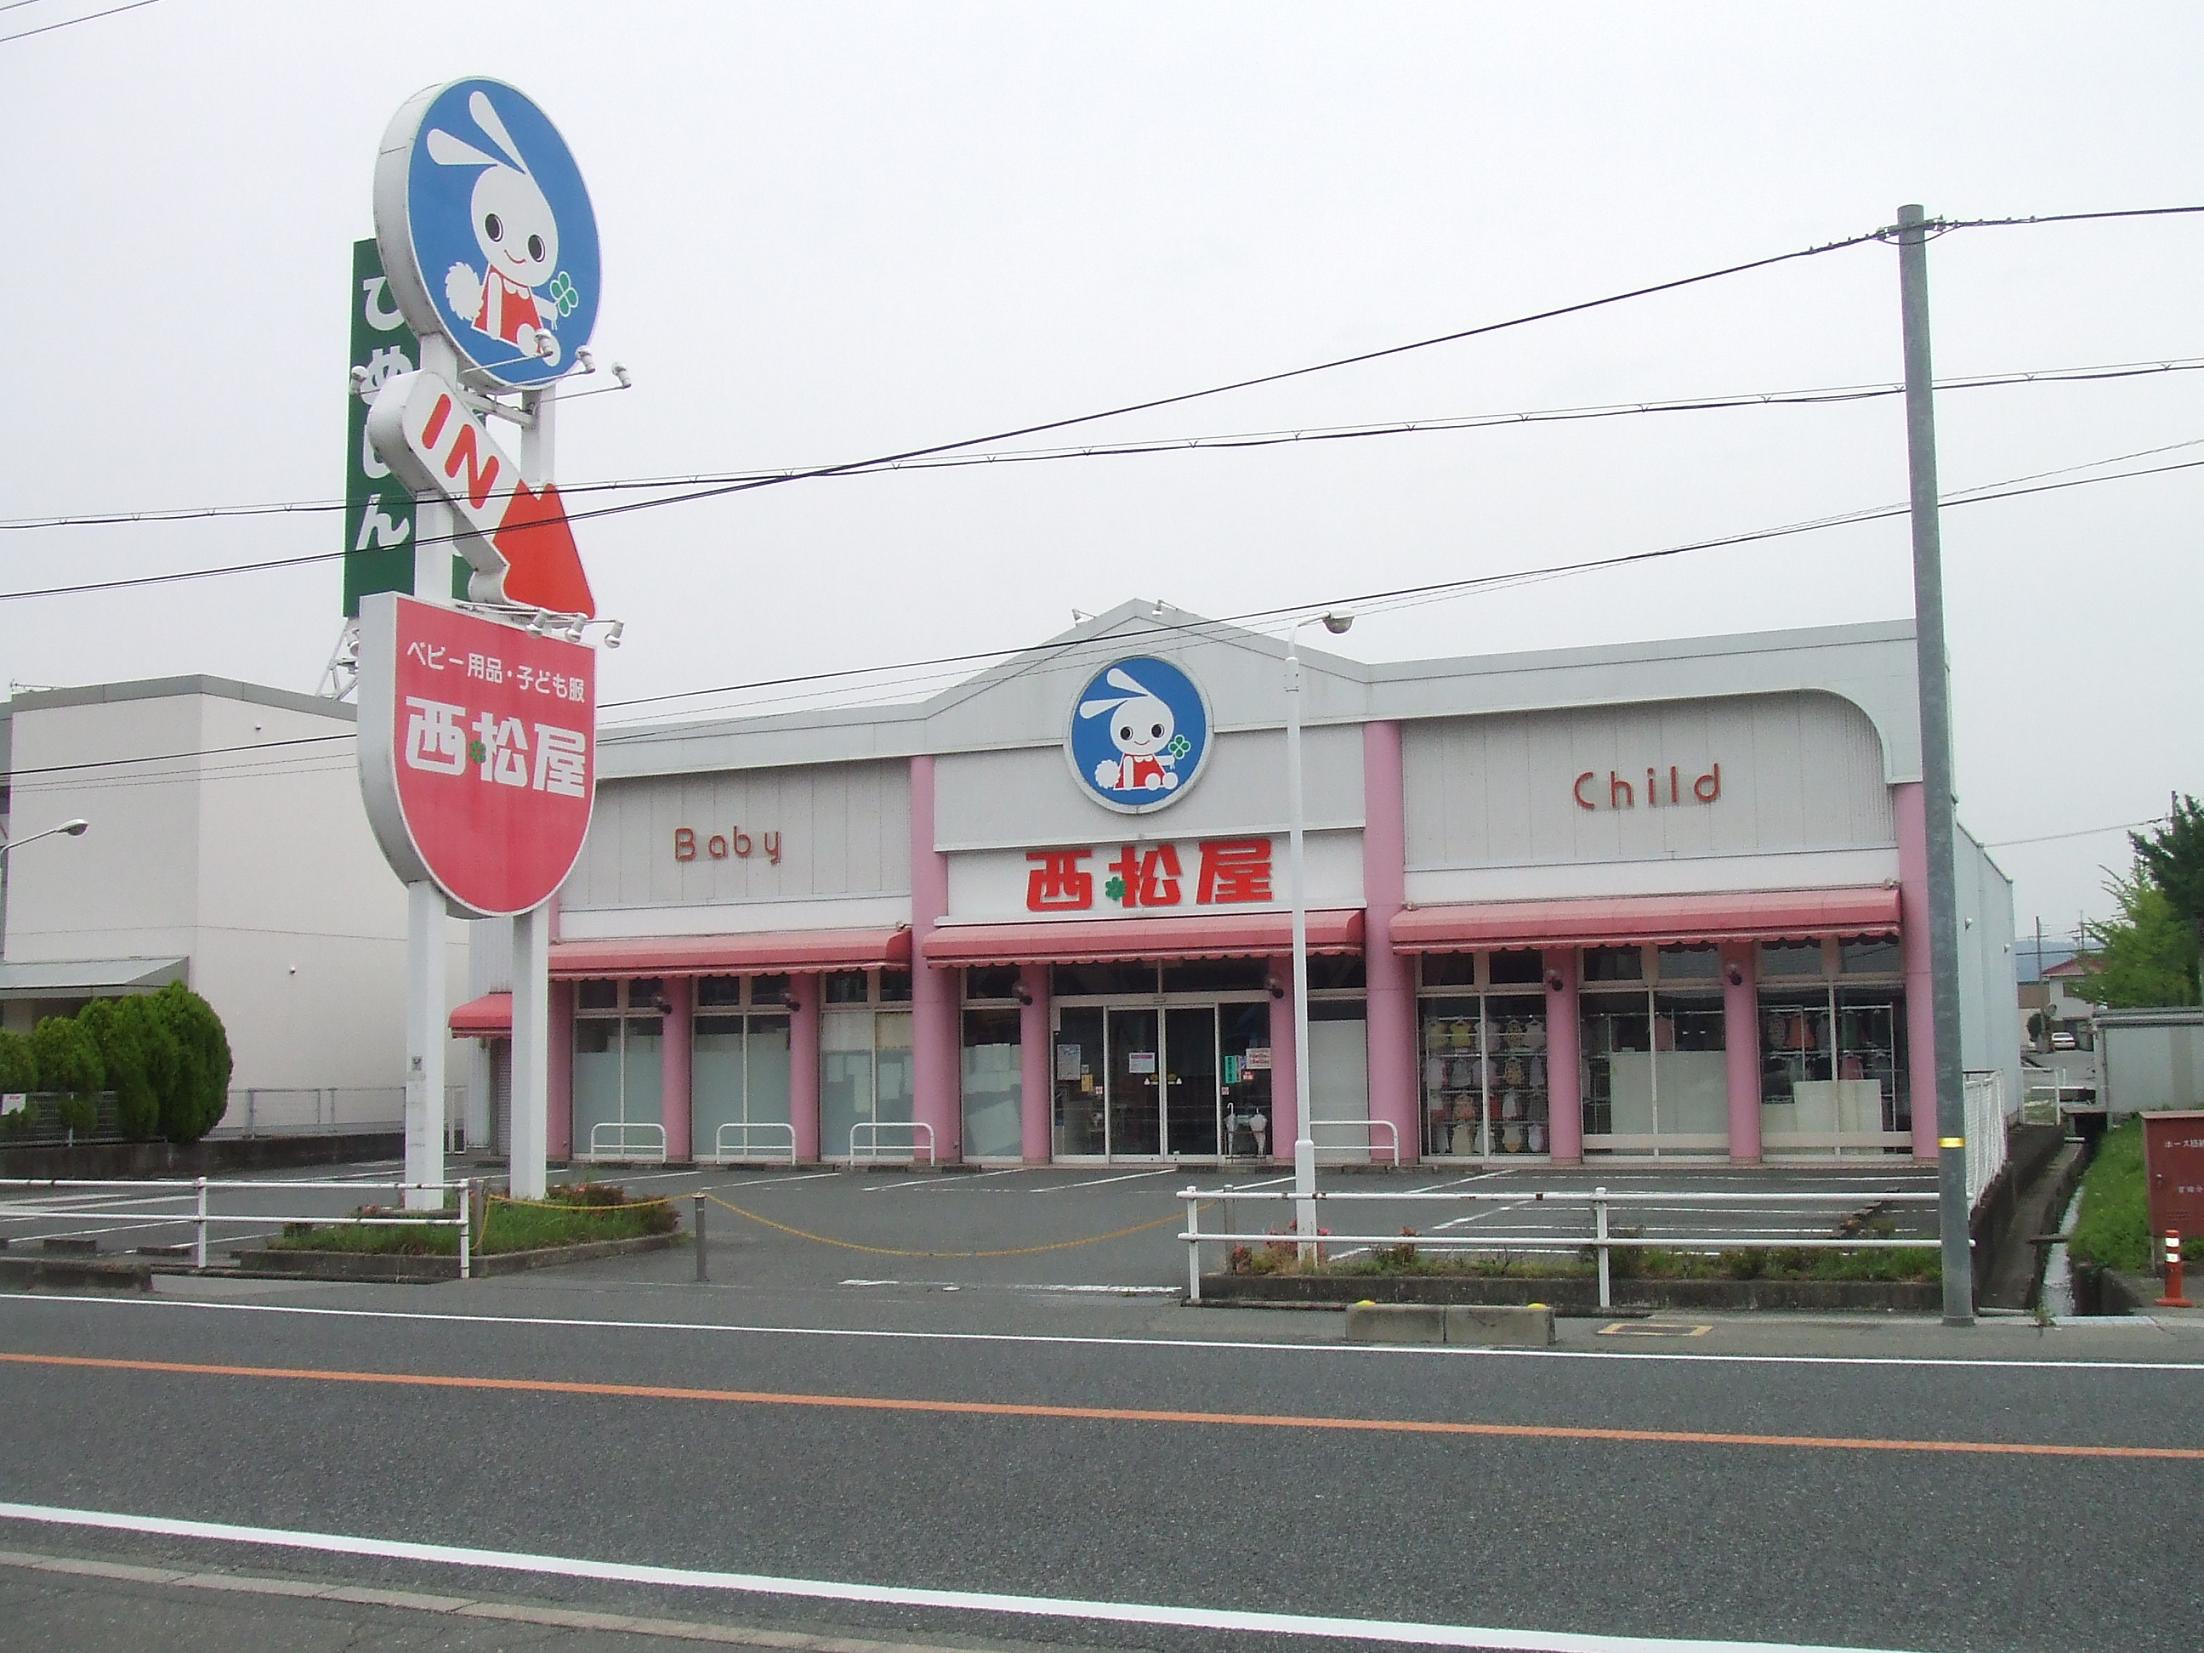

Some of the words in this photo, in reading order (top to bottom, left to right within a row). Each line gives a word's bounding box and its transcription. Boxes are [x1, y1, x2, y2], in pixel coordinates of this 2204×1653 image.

[421, 393, 500, 510] IN
[407, 641, 585, 704] ベビー用品・子ども服
[404, 696, 586, 799] 西松屋
[1574, 763, 1721, 811] Child
[675, 824, 781, 865] Baby
[1026, 838, 1273, 912] 西松屋
